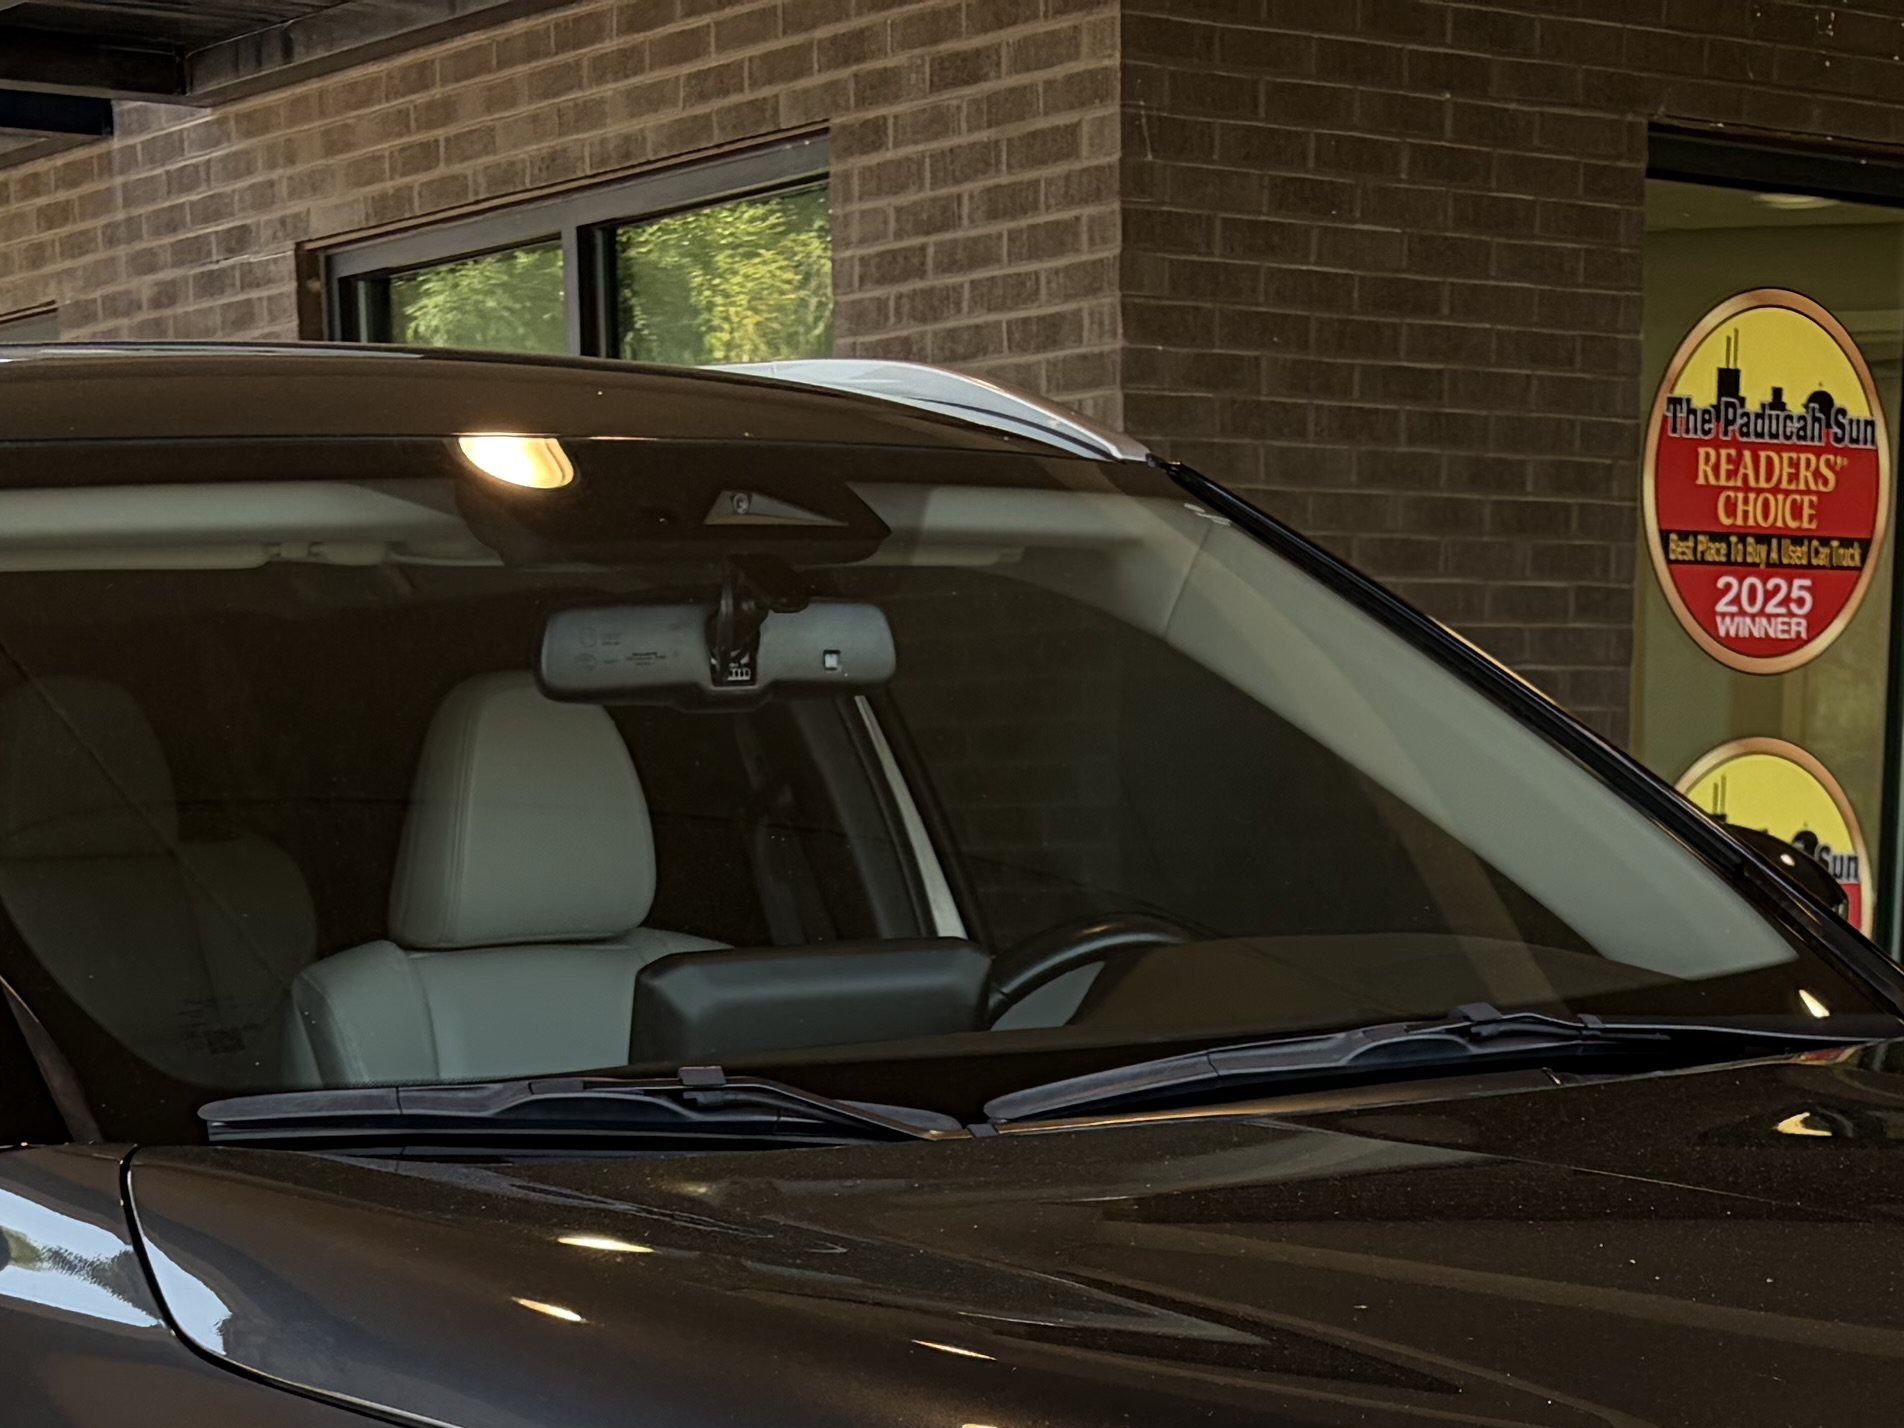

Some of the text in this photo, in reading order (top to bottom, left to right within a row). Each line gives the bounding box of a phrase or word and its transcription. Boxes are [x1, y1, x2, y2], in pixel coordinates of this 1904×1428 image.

[1667, 395, 1876, 448] The Paducah Sun
[1717, 491, 1818, 528] CHOICE
[1669, 533, 1695, 561] Best
[1697, 534, 1728, 562] Place
[1746, 536, 1768, 569] Buy
[1769, 538, 1779, 564] A
[1781, 538, 1809, 565] Used
[1715, 576, 1813, 615] 2025
[1715, 615, 1808, 640] WINNER
